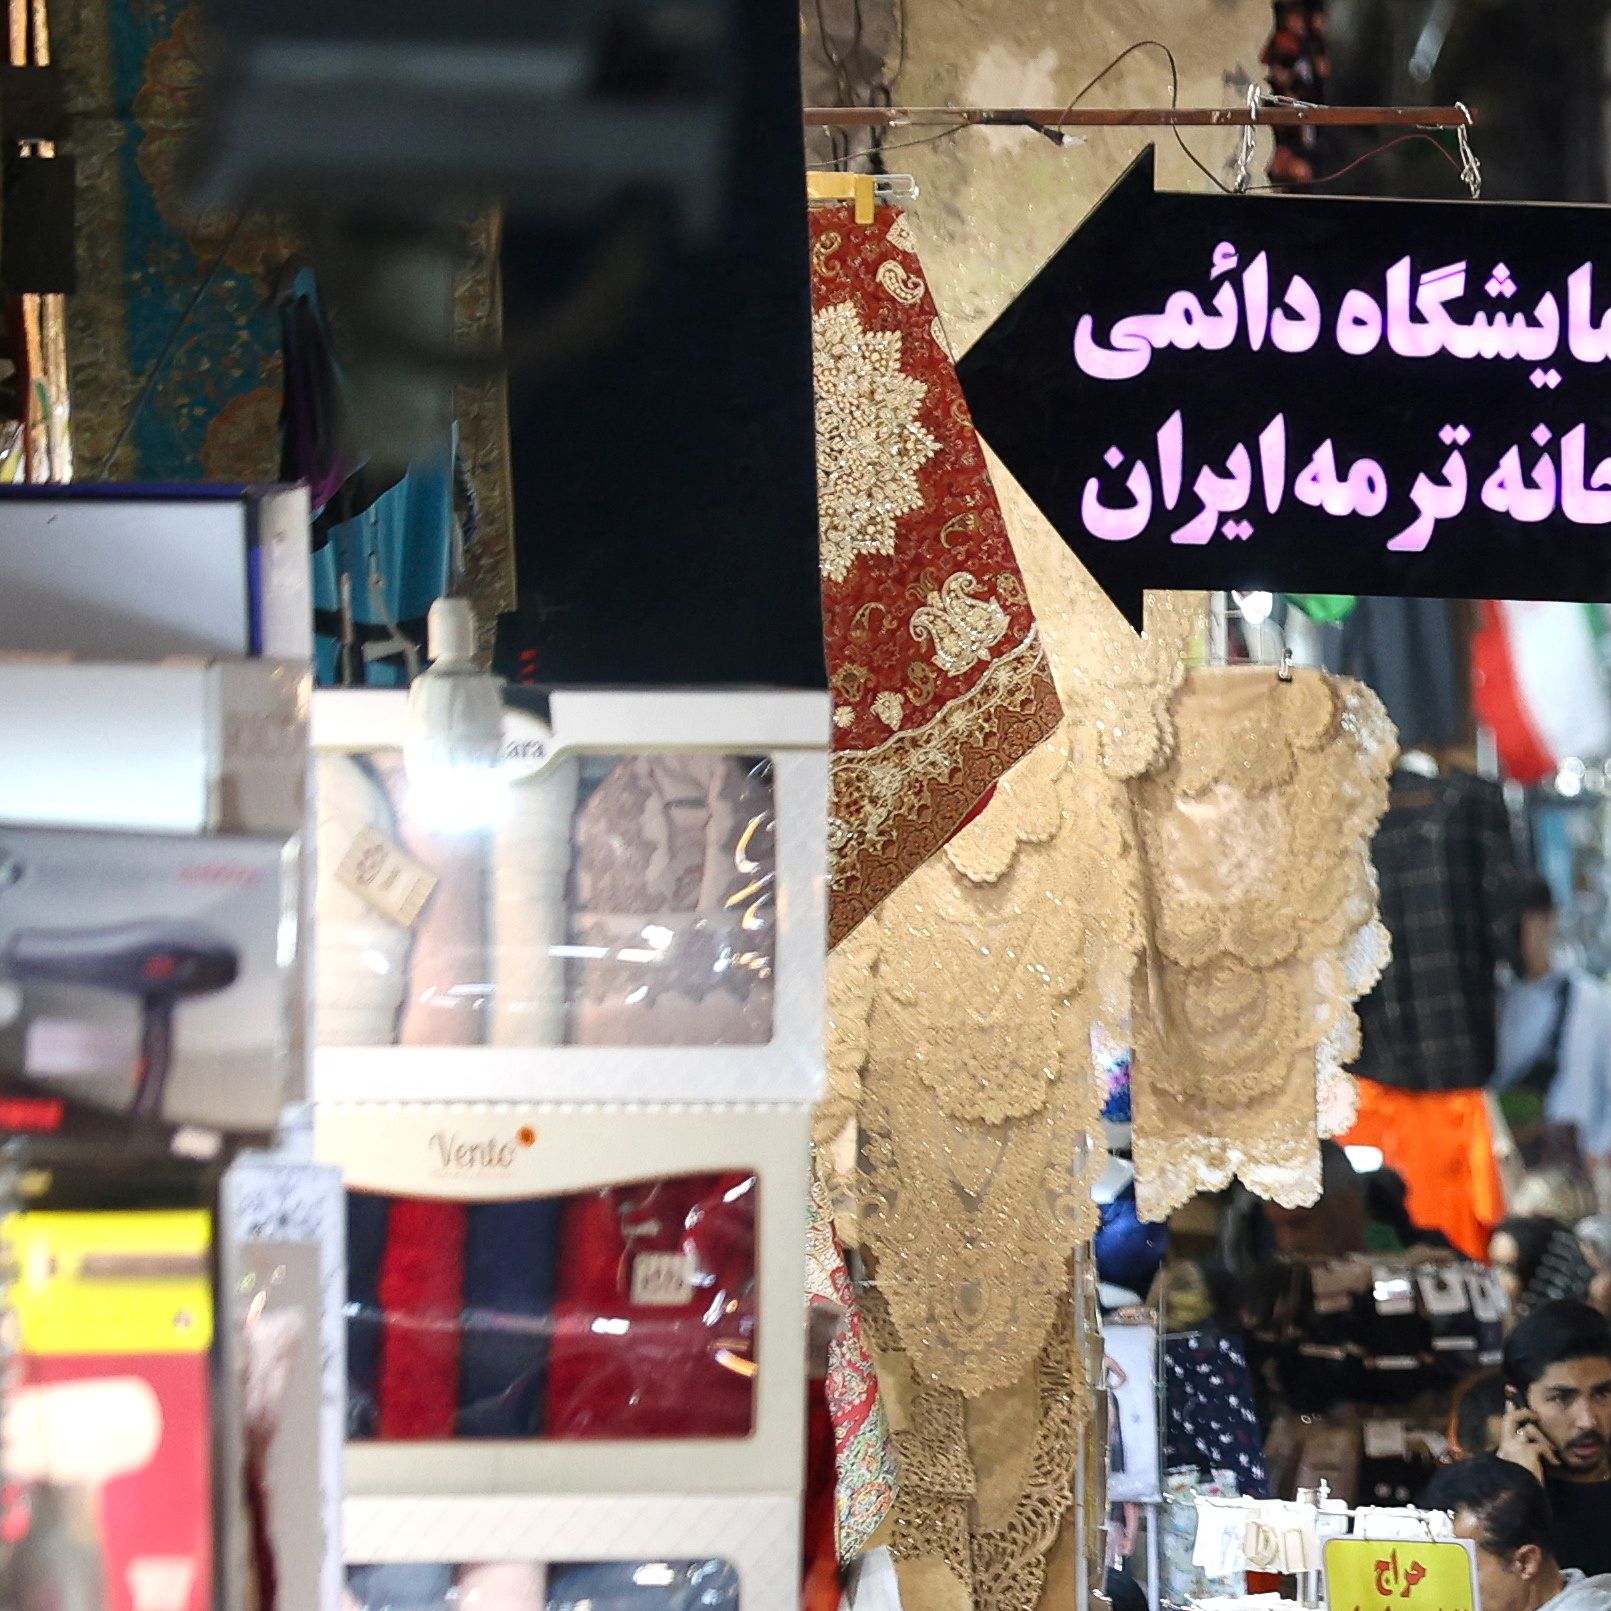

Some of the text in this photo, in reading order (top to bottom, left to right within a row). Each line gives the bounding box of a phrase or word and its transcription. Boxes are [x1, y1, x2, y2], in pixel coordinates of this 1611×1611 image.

[1073, 240, 1322, 380] دائمی
[1080, 409, 1286, 545] ایران
[1293, 423, 1471, 552] ترمه
[1373, 1548, 1427, 1599] حراج
